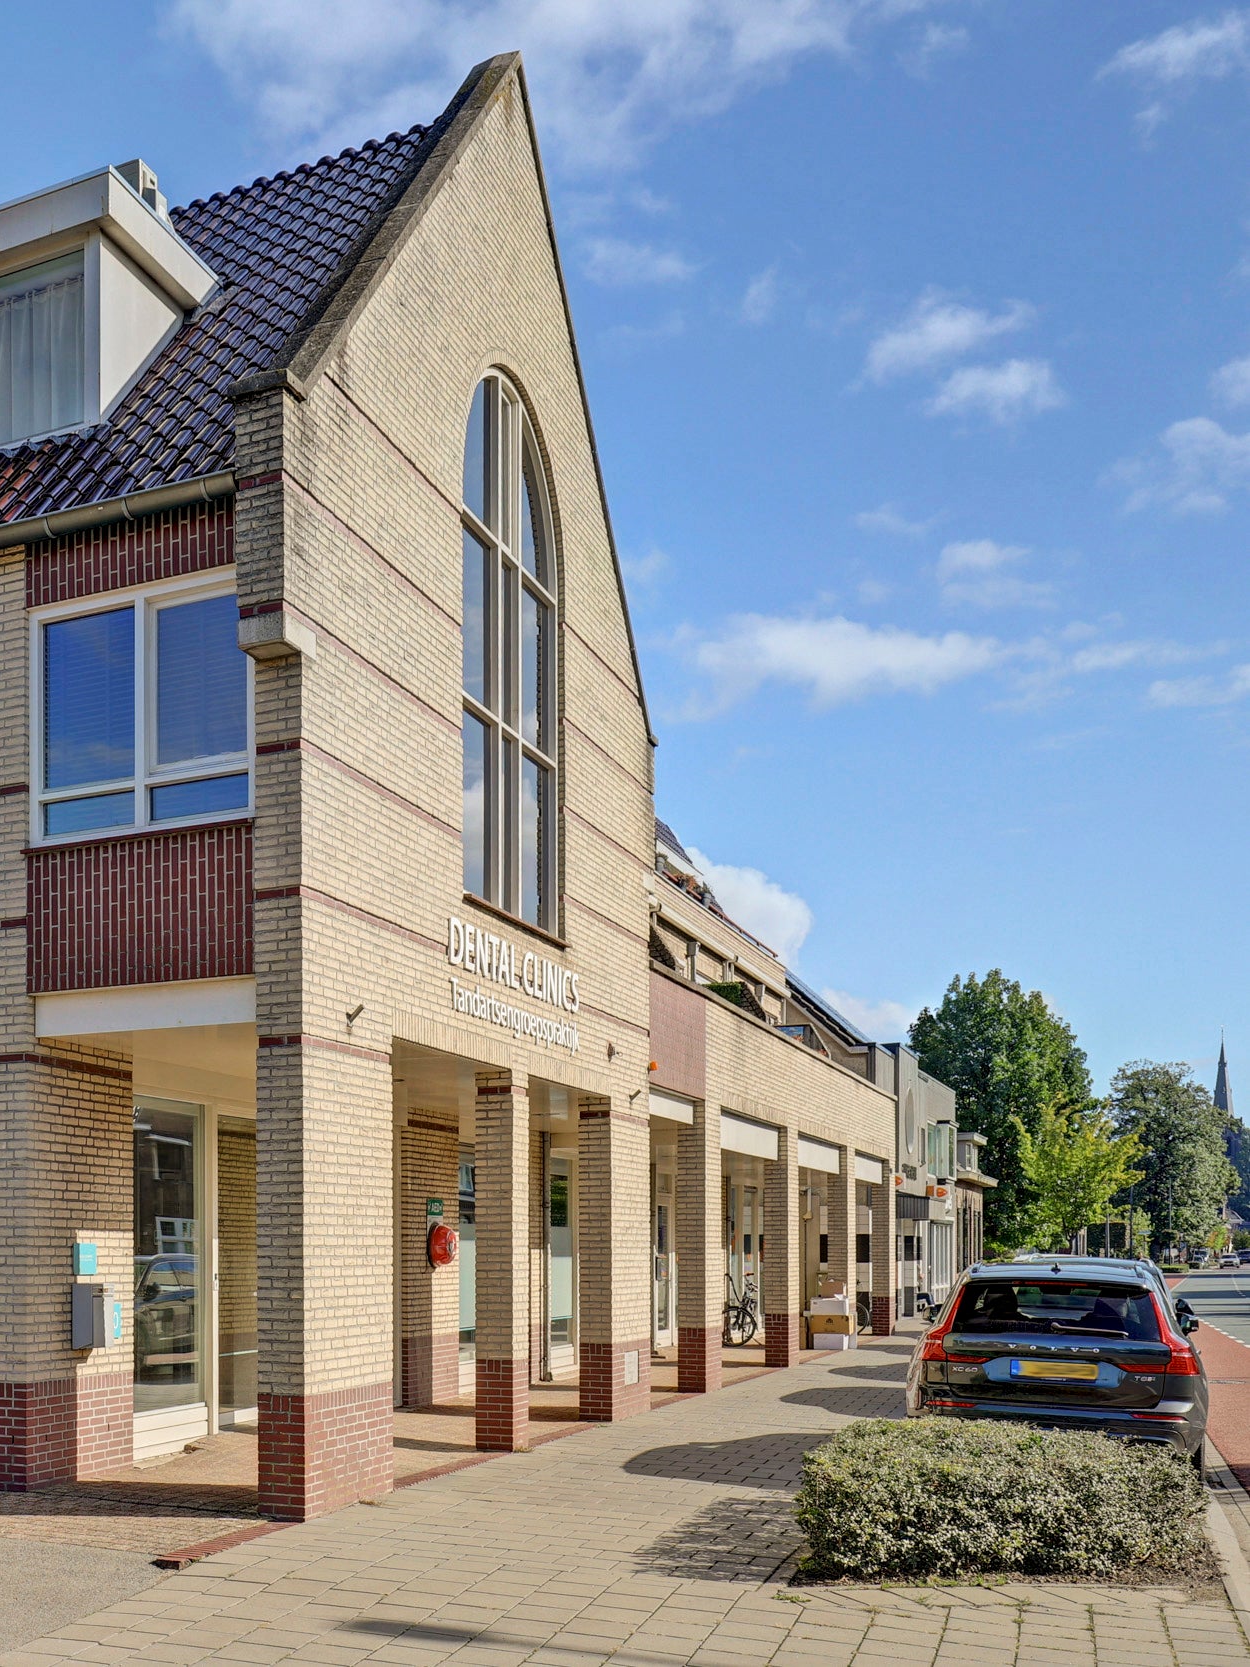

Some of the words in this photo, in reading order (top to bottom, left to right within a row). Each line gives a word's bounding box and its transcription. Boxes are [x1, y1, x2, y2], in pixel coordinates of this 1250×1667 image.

[449, 917, 520, 989] DENTAL
[522, 951, 580, 1014] CLINICS
[449, 976, 580, 1056] Tandartsengroepspraktijk
[1008, 1343, 1100, 1353] VOLVO
